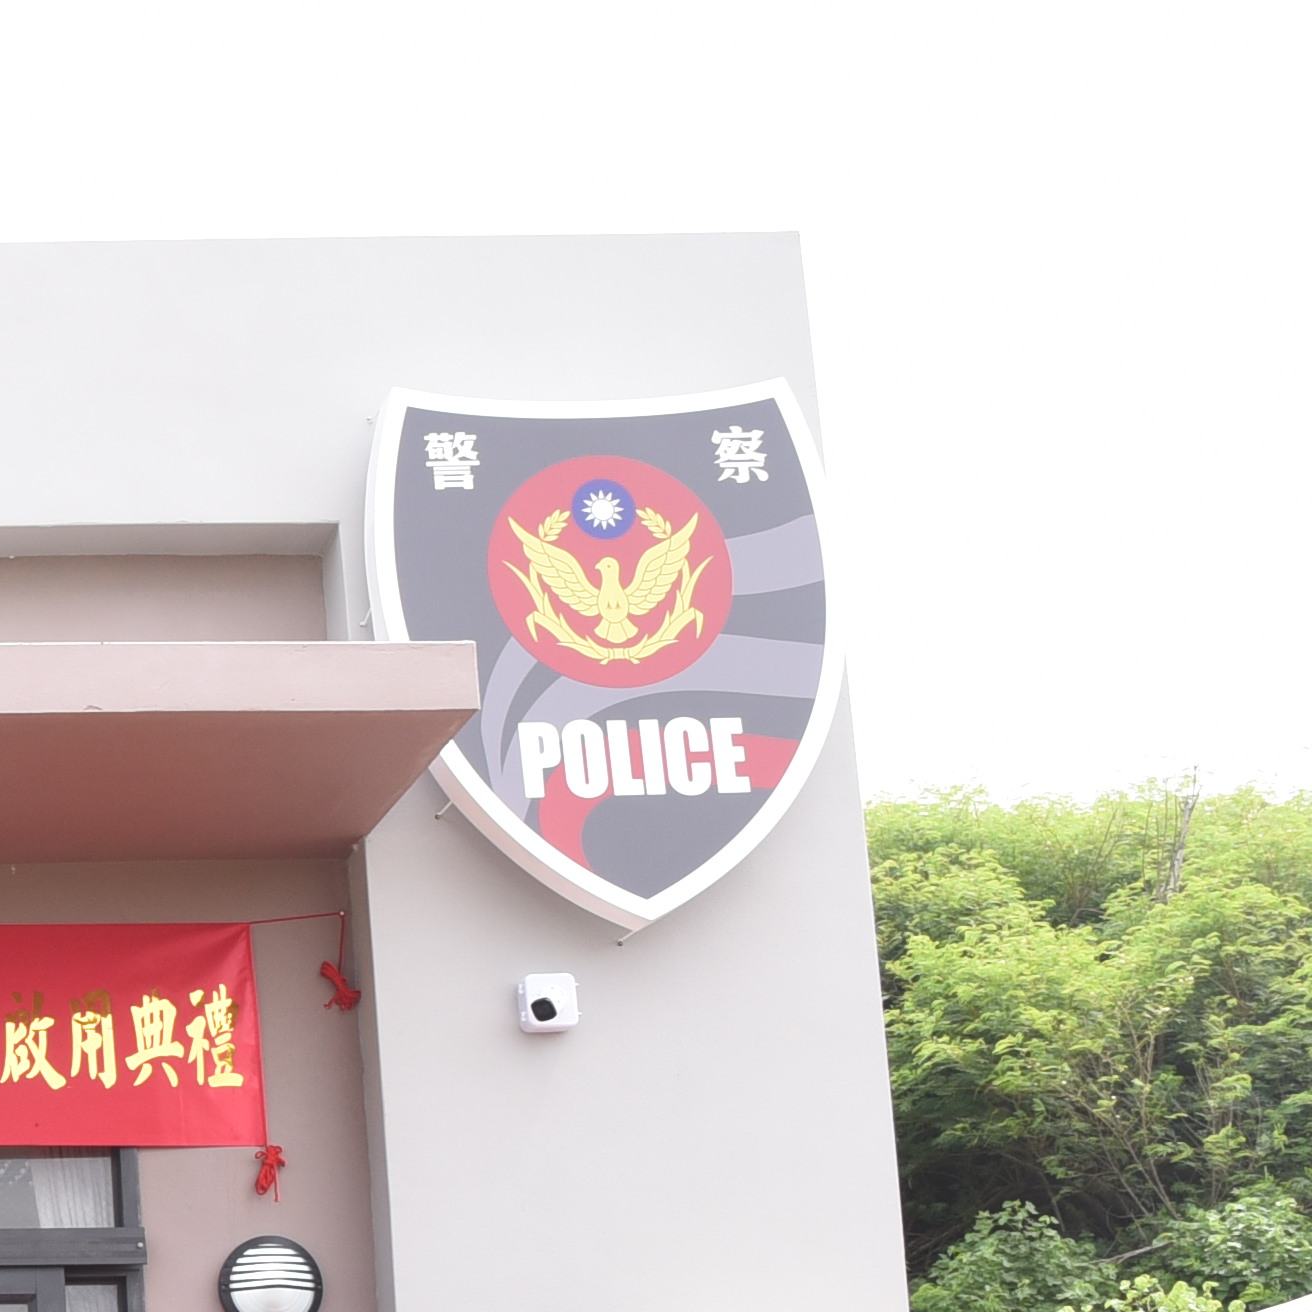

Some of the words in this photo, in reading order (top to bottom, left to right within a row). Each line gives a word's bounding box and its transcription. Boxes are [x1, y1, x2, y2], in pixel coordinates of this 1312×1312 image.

[424, 431, 481, 490] 警
[711, 425, 769, 484] 察
[517, 716, 752, 800] POLICE
